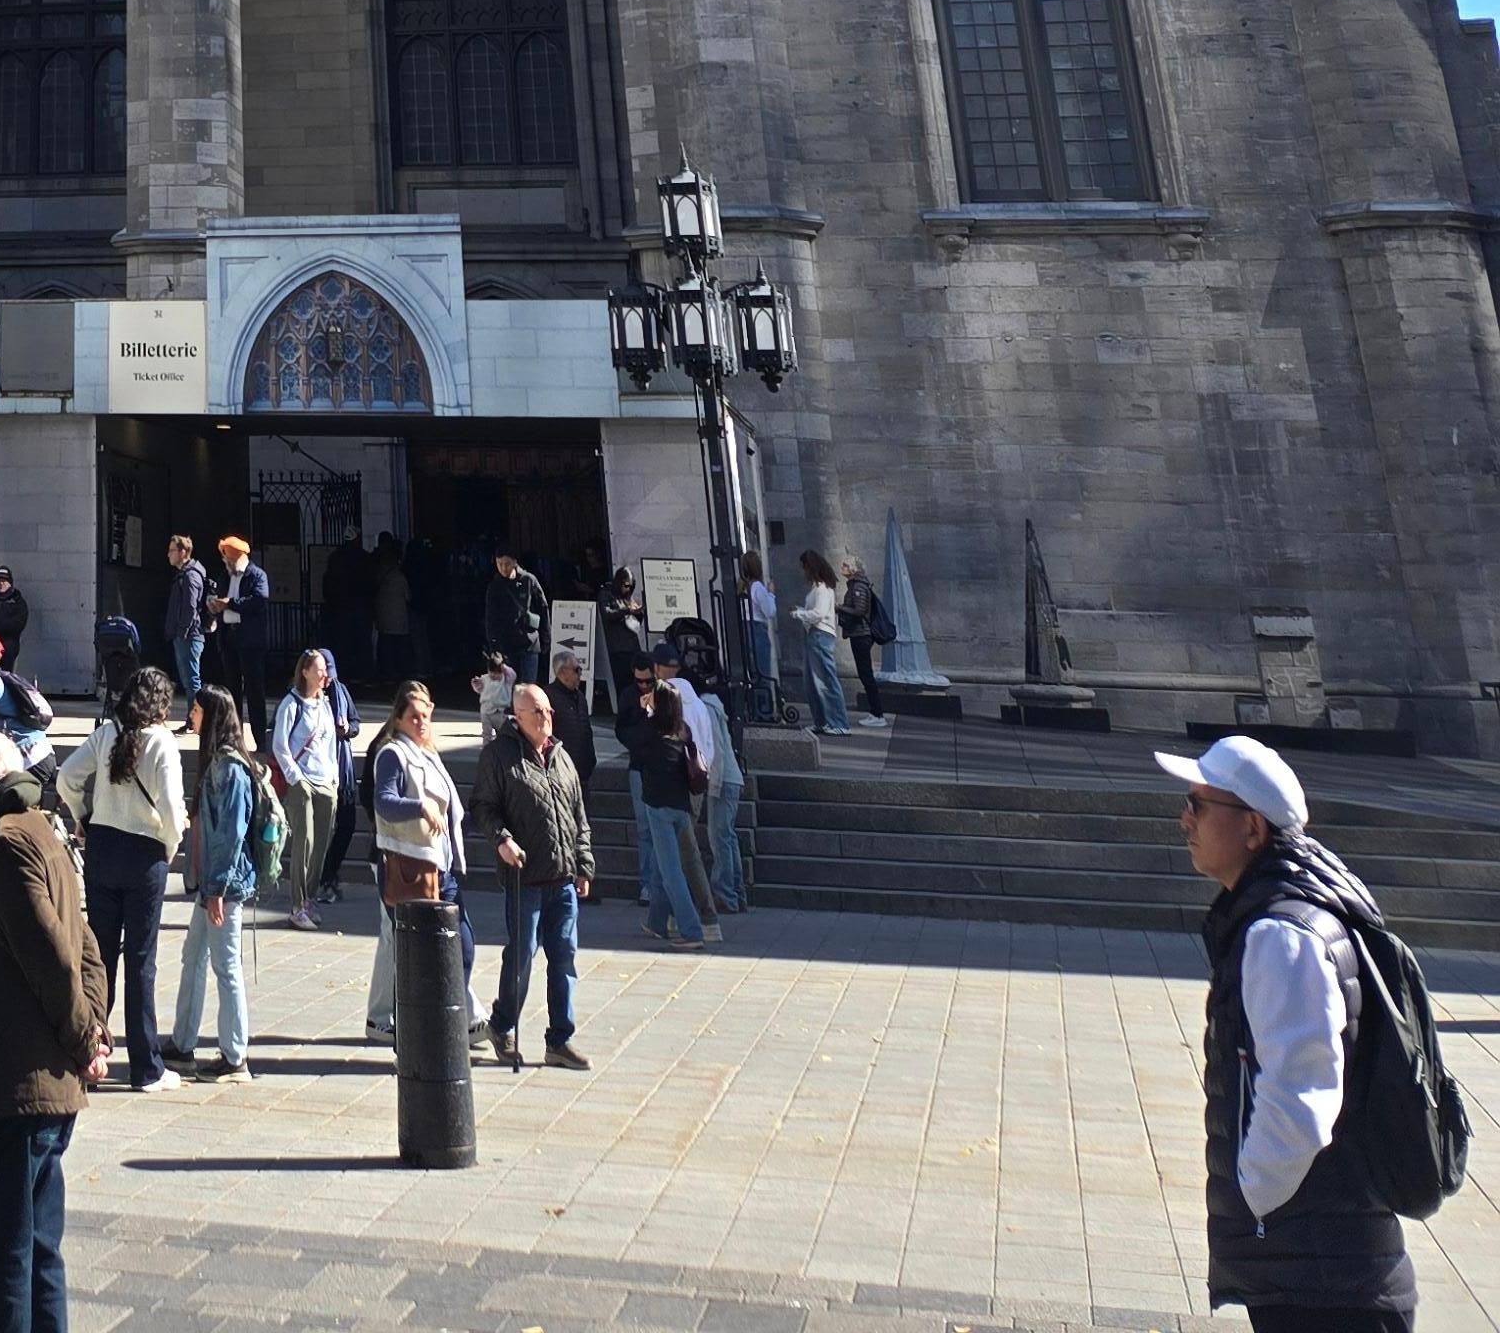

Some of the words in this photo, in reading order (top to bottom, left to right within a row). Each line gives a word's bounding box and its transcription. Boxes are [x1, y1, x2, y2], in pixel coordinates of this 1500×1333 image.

[120, 342, 198, 358] Billetterie
[133, 372, 158, 382] Ticket
[160, 372, 185, 382] Office
